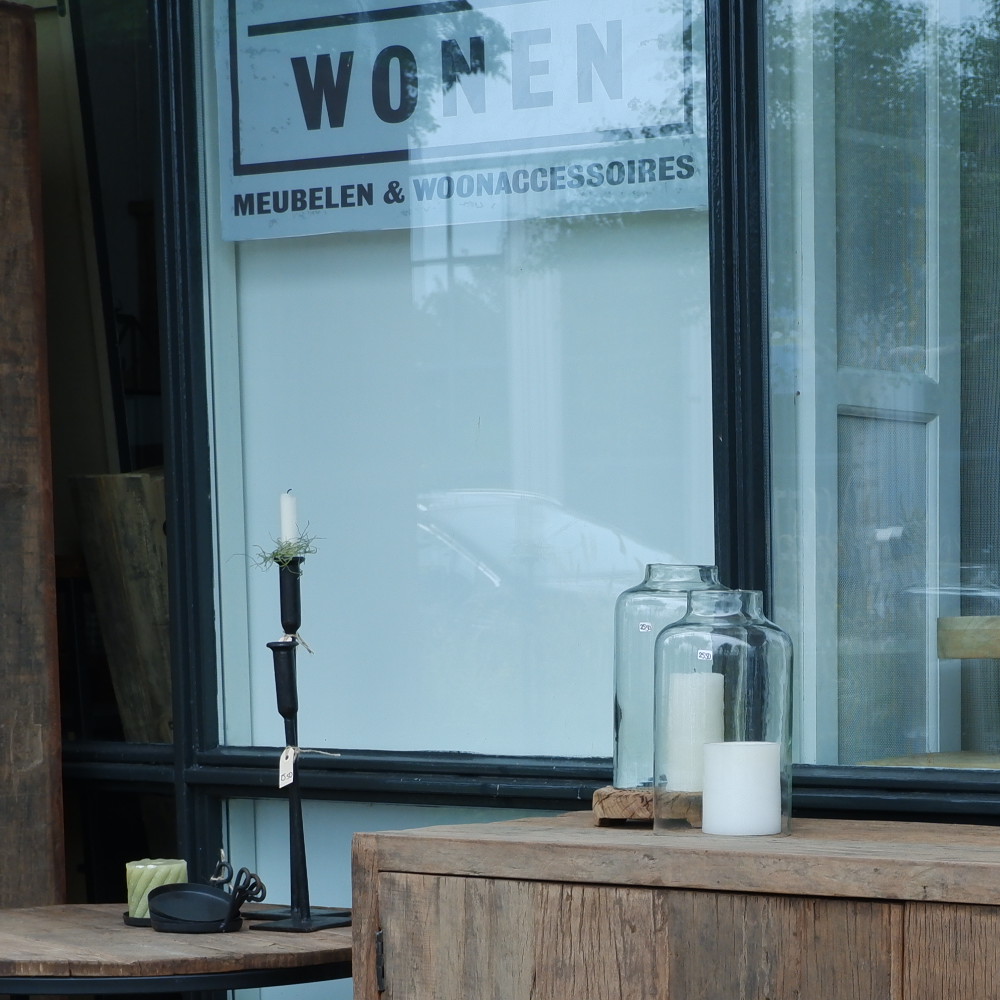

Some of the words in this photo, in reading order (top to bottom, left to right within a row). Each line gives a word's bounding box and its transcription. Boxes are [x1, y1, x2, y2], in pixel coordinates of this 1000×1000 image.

[290, 19, 625, 131] WONEN
[233, 182, 375, 217] MEUBELEN
[383, 180, 406, 205] &
[412, 154, 696, 202] WOONACCESSOIRES
